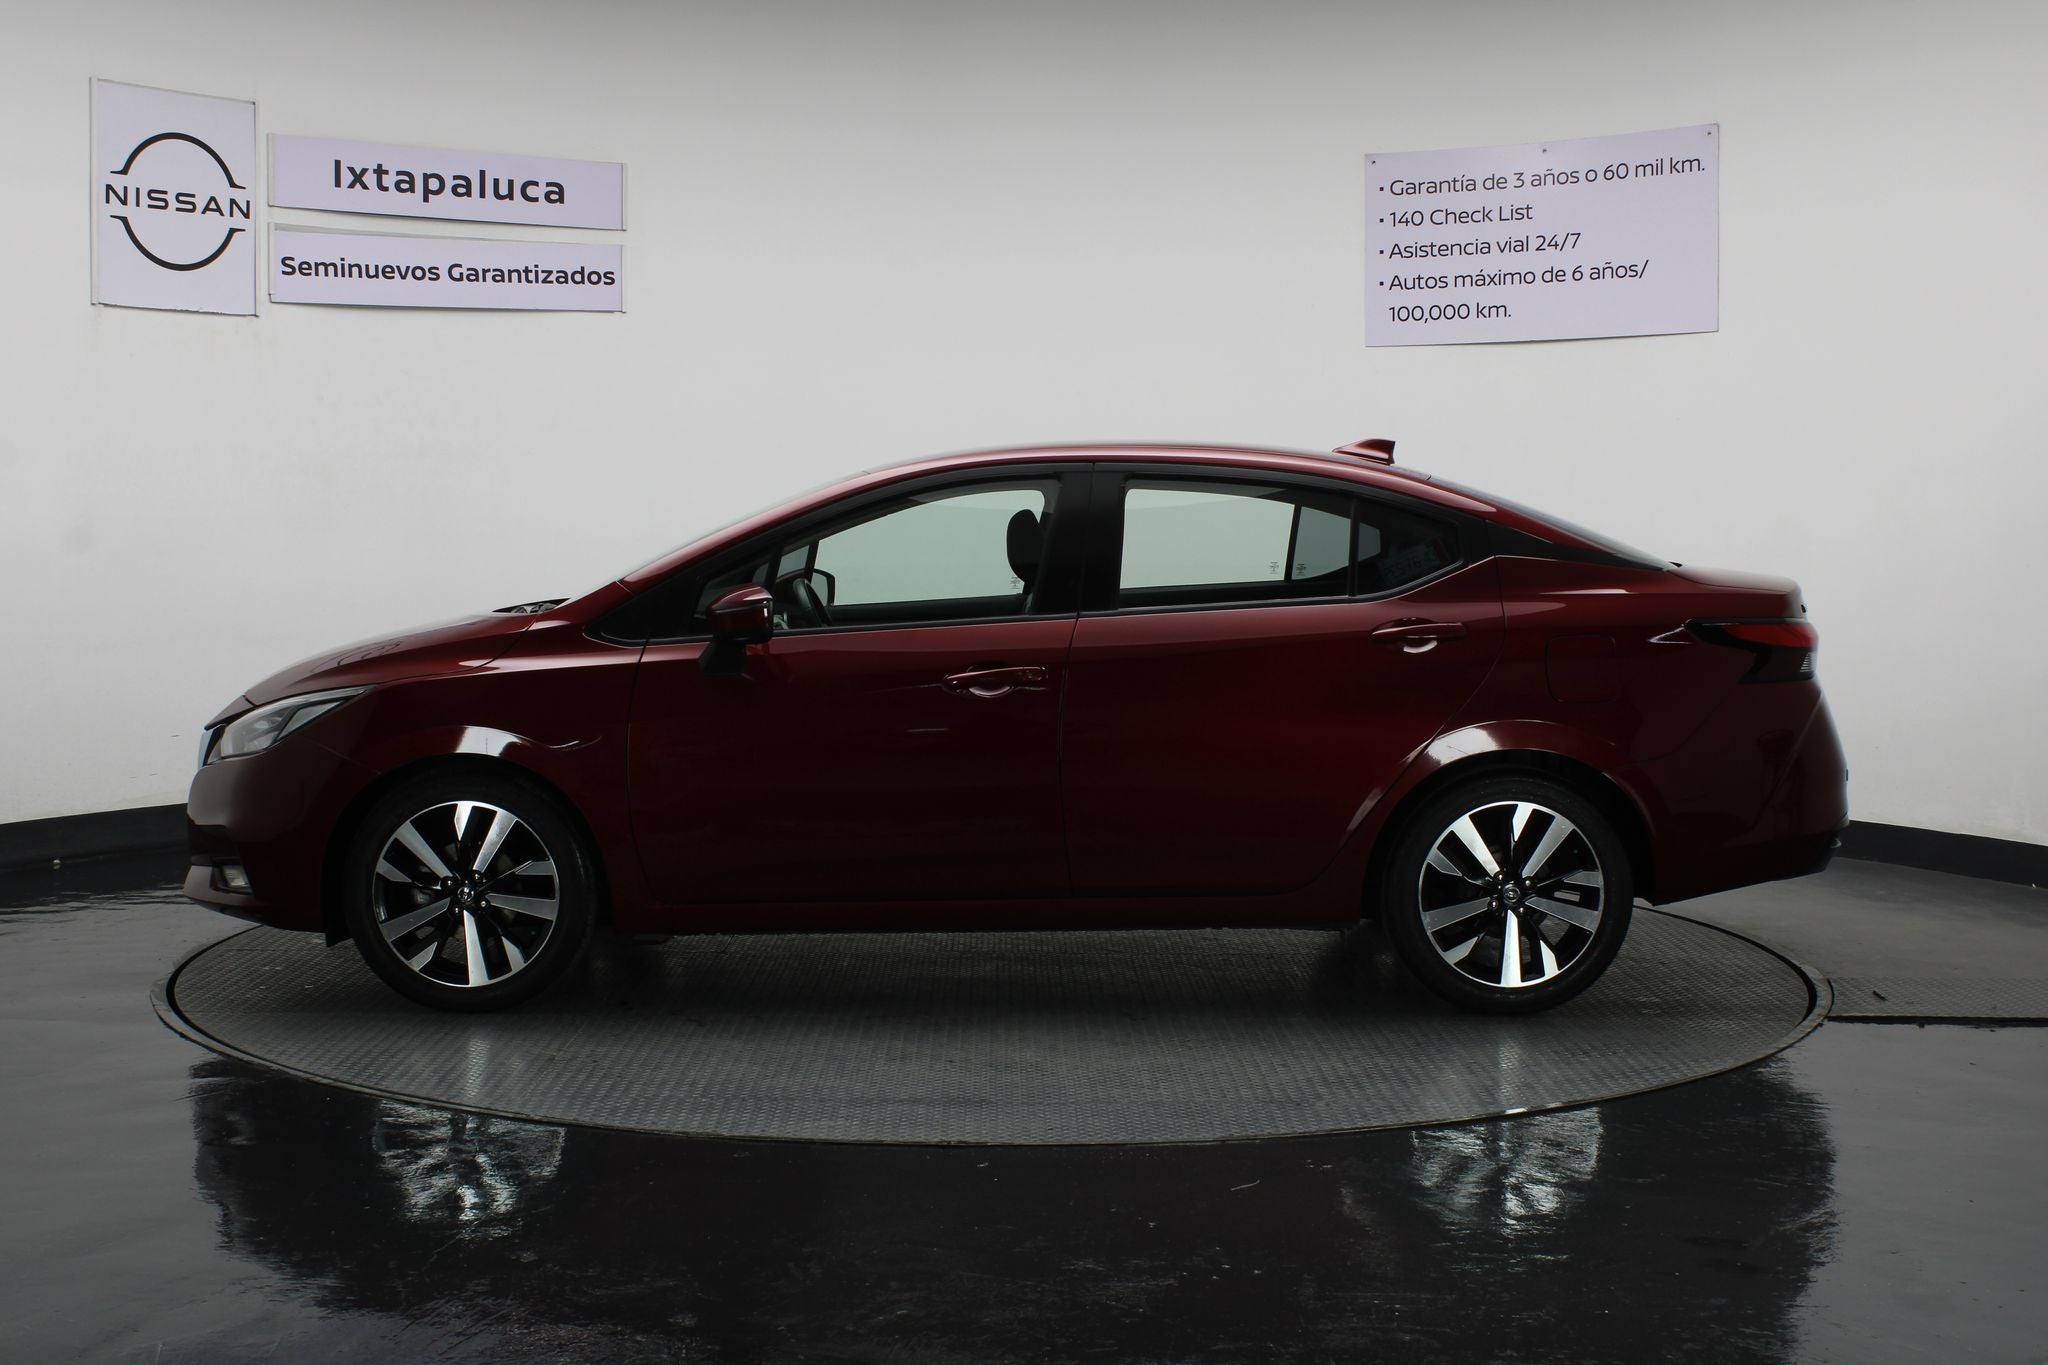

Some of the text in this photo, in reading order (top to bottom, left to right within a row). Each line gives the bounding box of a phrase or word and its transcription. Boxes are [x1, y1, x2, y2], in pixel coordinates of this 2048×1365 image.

[333, 159, 566, 205] Ixtapaluca
[1389, 156, 1706, 196] Garantía de 3 años o 60 mil km.
[105, 183, 251, 220] NISSAN
[1389, 203, 1533, 228] 140 Check List
[1388, 232, 1582, 260] Asistencia vial 24/7
[280, 256, 616, 286] Seminuevos Garantizados
[1388, 259, 1649, 291] Autos máximo de 6 años/
[1388, 301, 1512, 325] 100,000 km.
